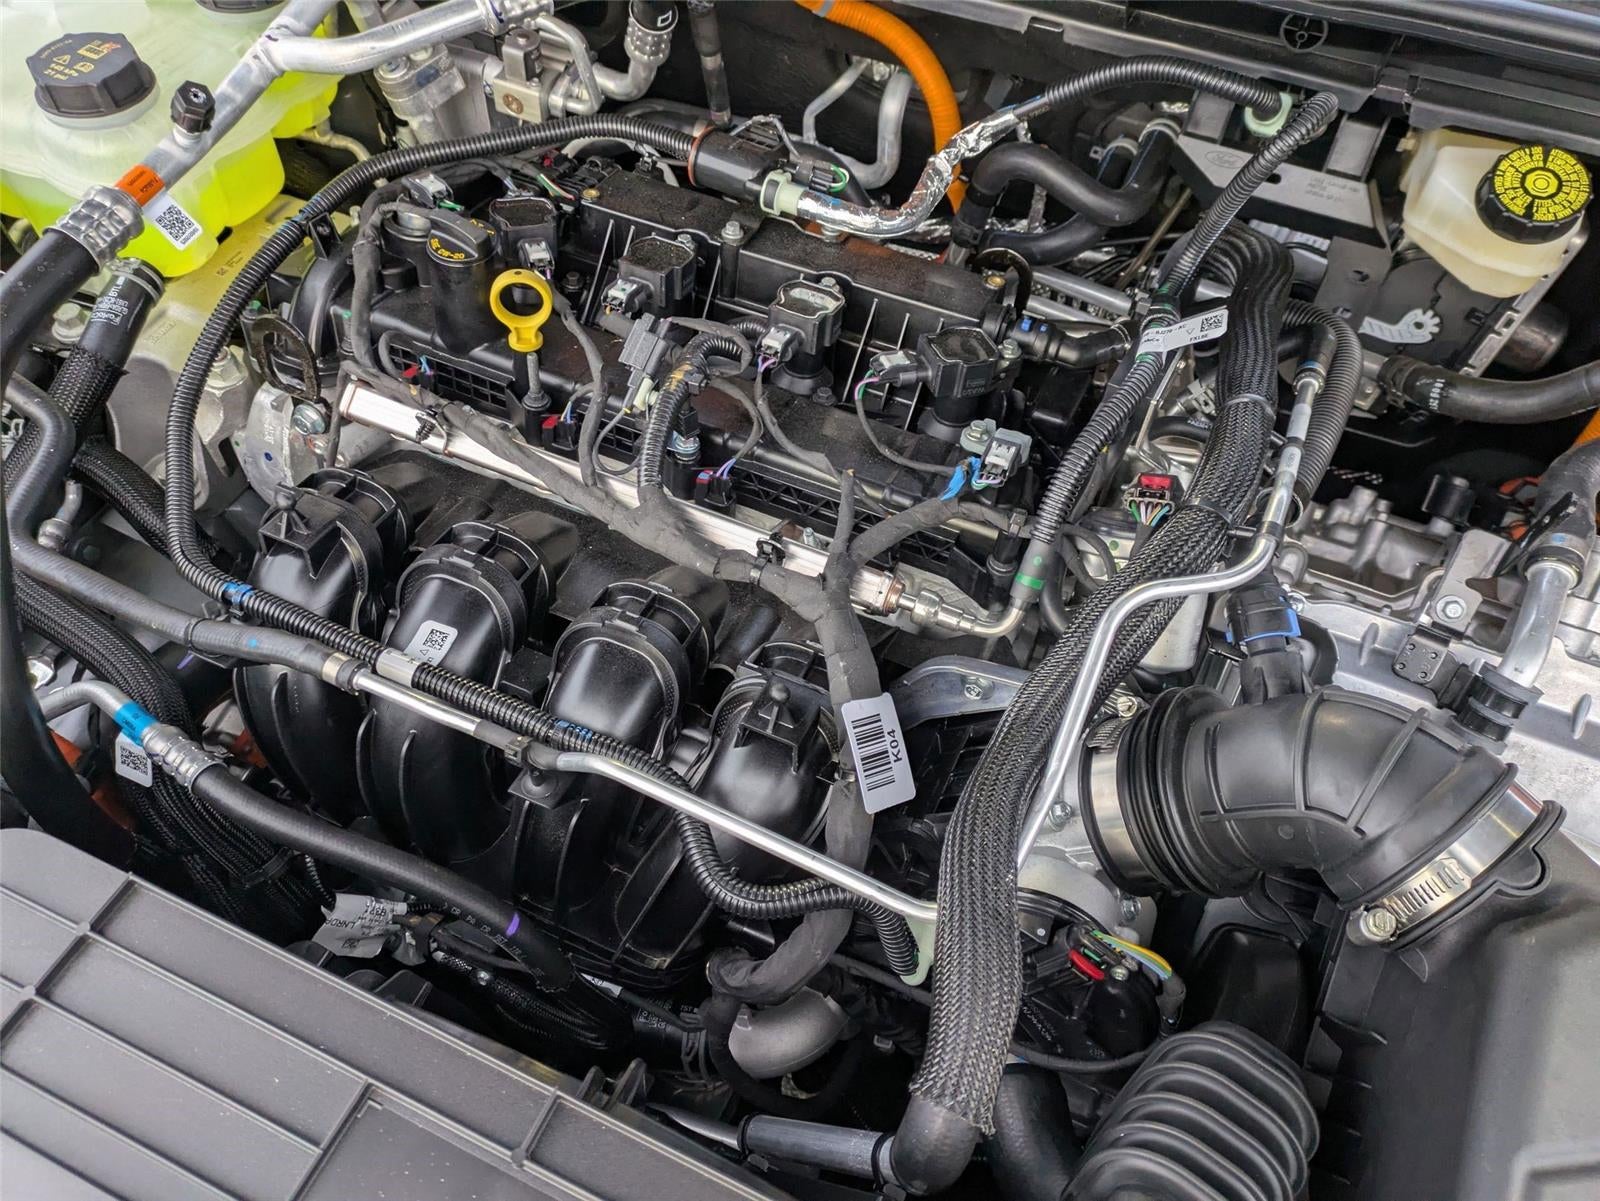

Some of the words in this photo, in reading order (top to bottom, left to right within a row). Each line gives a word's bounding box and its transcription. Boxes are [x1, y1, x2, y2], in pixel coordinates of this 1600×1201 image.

[431, 238, 441, 250] SAE
[437, 248, 465, 259] 0W-20
[887, 728, 903, 764] K04
